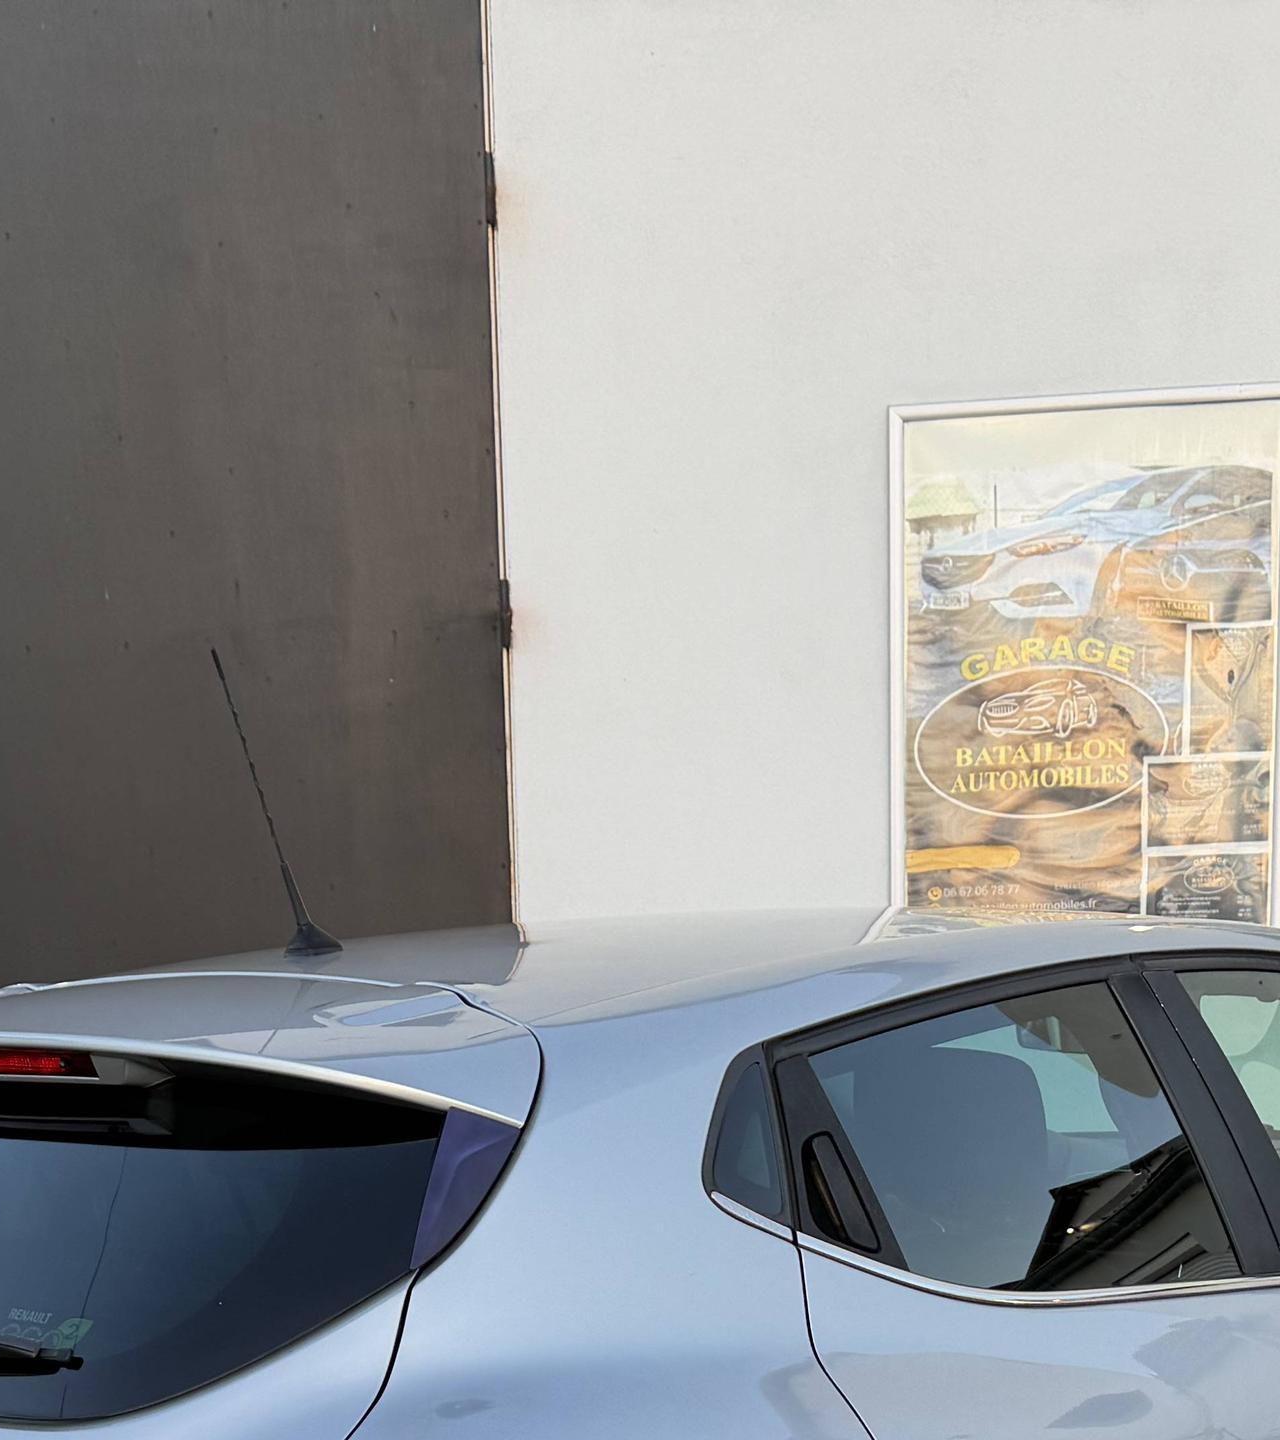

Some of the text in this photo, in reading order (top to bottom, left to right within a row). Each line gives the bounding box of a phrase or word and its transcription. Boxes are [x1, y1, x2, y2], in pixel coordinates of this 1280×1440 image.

[960, 634, 1136, 682] GARAGE
[955, 737, 1126, 770] BATAILLON
[950, 763, 1130, 794] AUTOMOBILES
[7, 1308, 53, 1324] RENAULT
